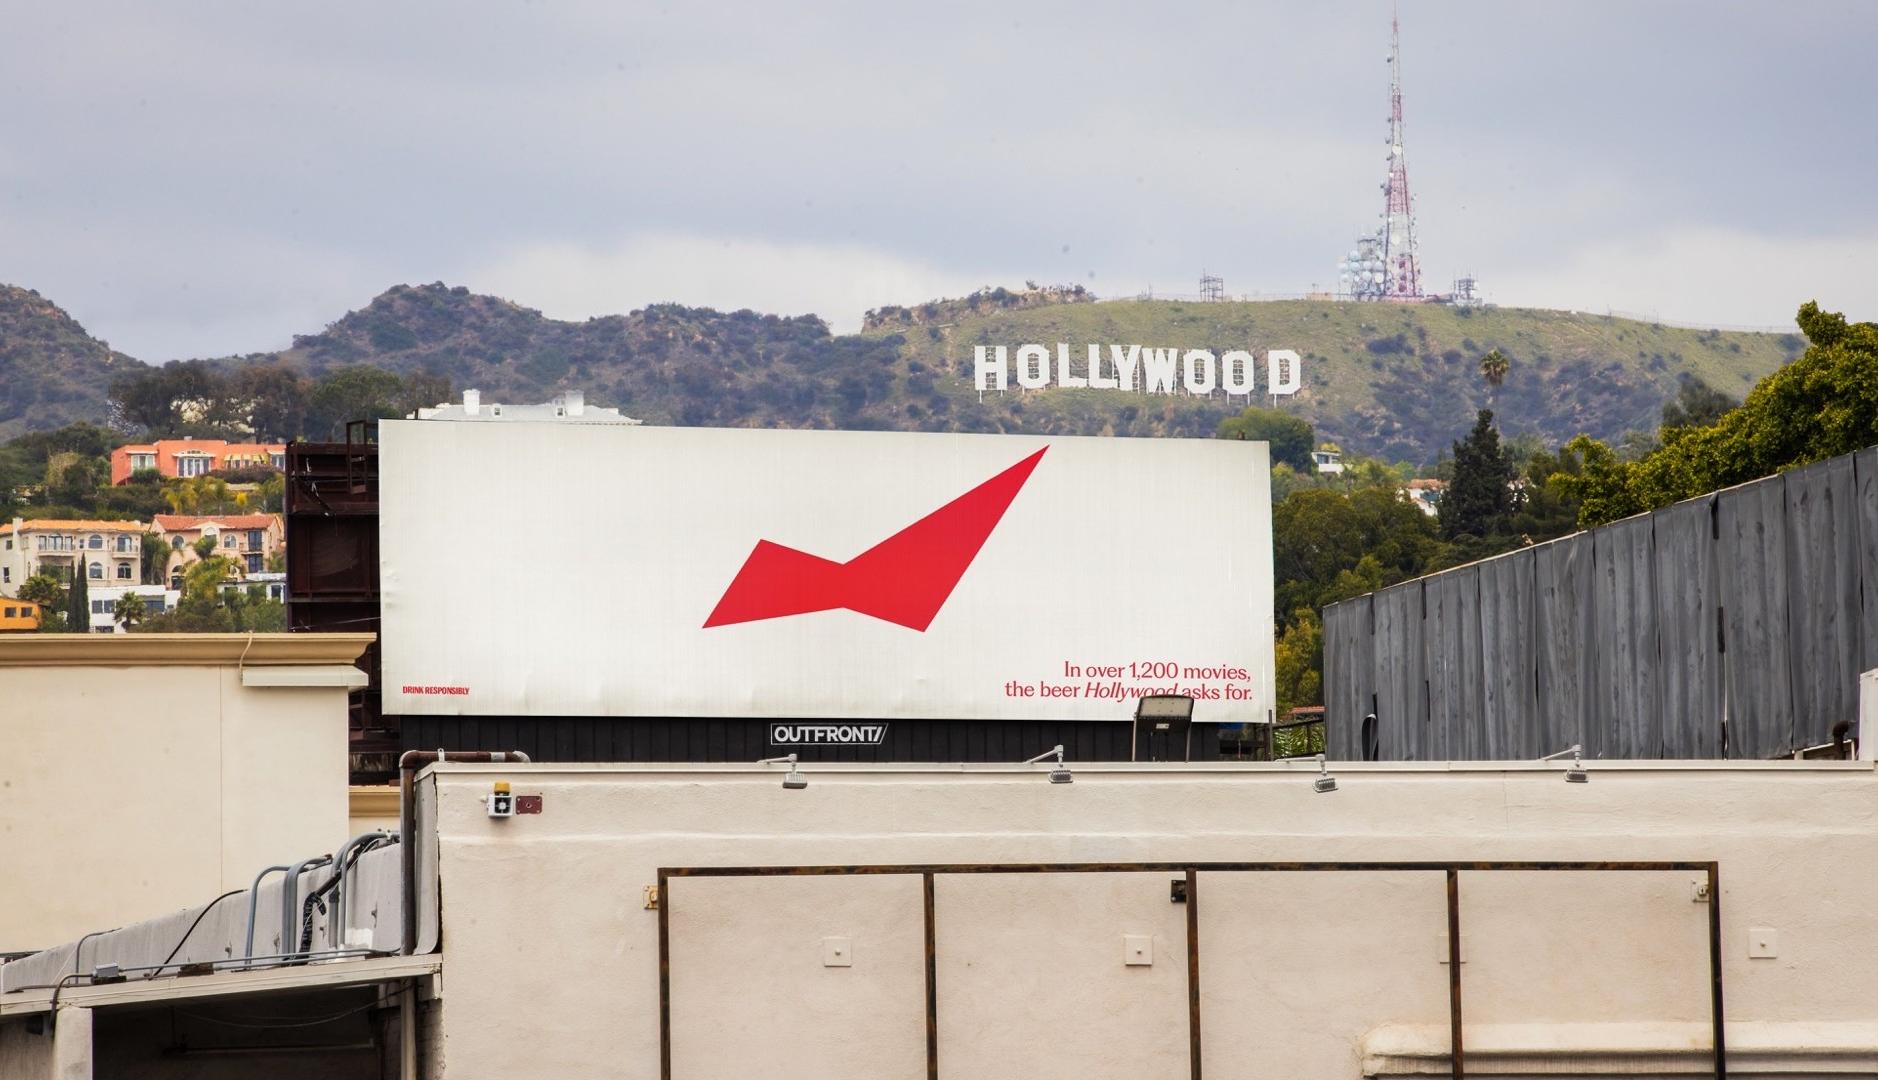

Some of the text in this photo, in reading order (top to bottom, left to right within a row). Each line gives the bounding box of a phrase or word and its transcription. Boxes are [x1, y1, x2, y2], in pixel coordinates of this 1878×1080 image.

[974, 343, 1302, 397] HOLLYWOOD
[1064, 660, 1251, 681] In over 1,200 movies,
[402, 686, 470, 695] DRINK RESPONSIBLY
[1004, 681, 1253, 703] the beer Hollywood asks for.
